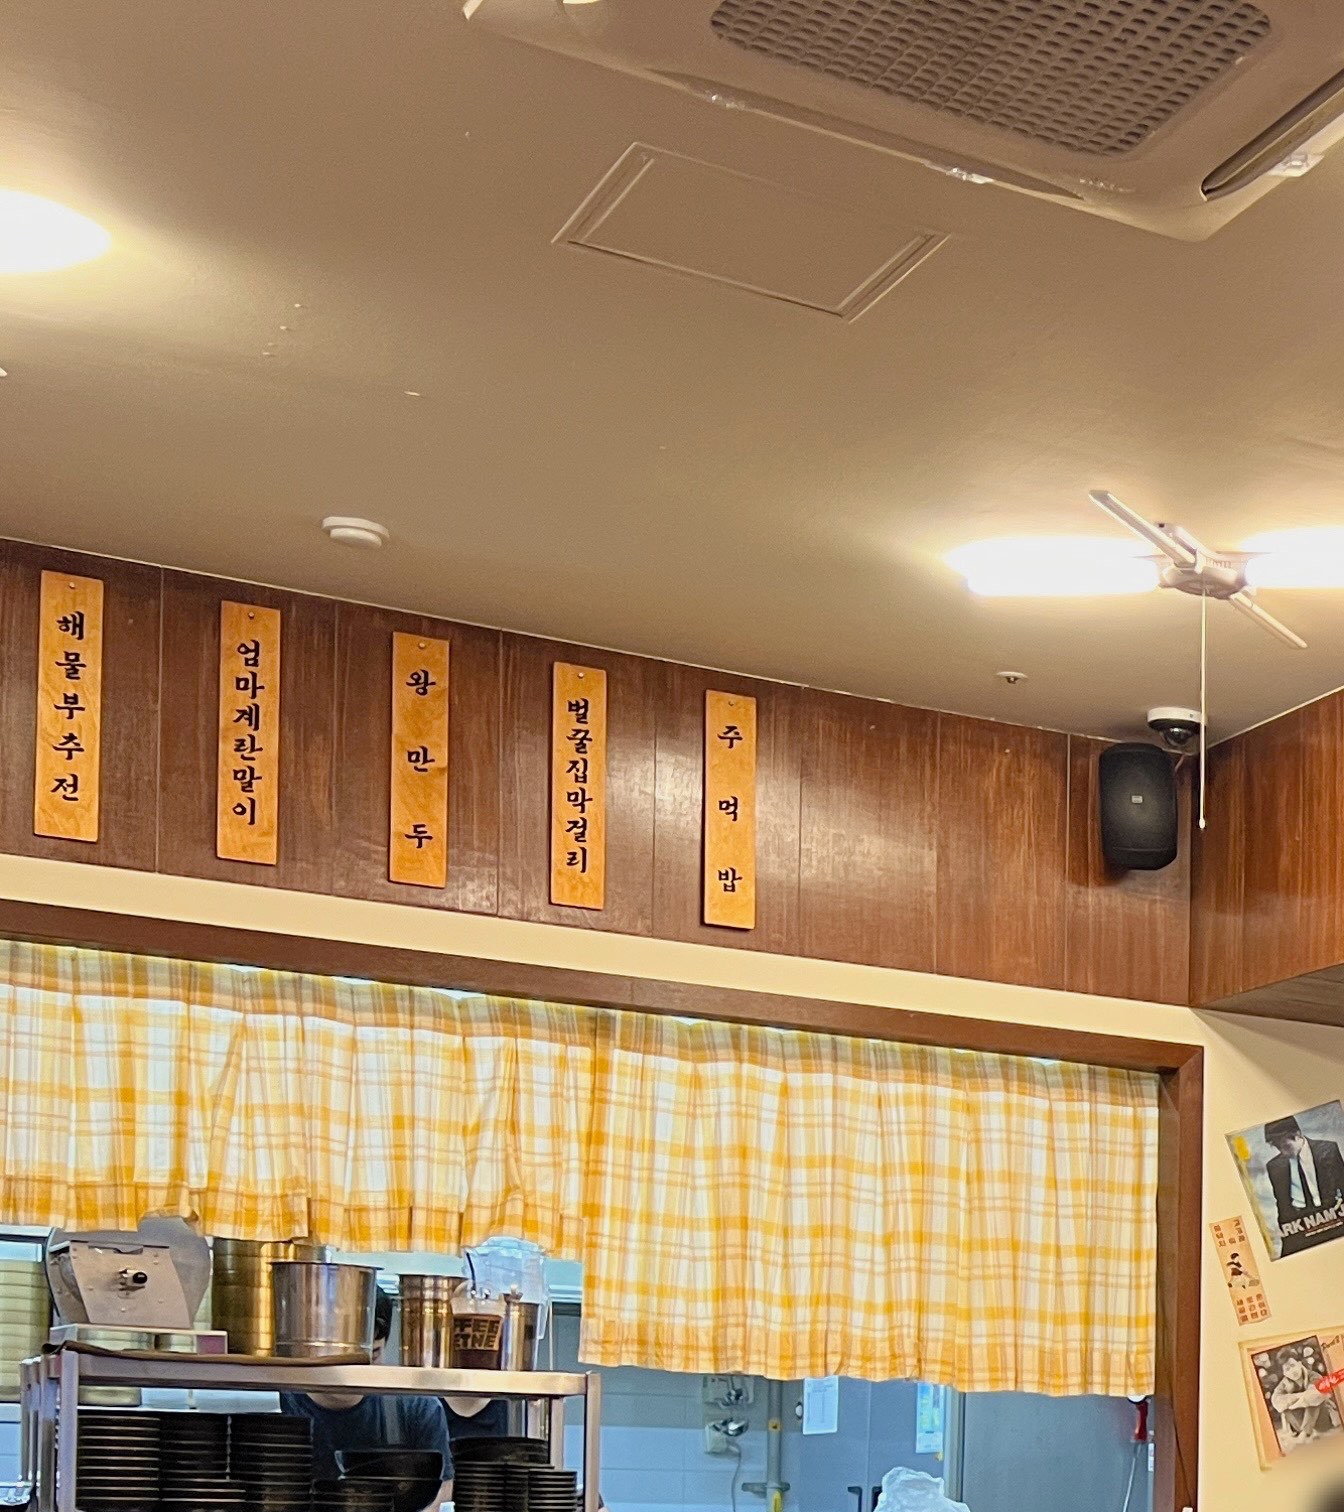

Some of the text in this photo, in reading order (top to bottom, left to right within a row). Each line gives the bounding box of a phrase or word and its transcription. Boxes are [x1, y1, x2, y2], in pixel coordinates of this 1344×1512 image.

[50, 609, 88, 803] 해물부추전
[231, 638, 266, 827] 엄마계란말이
[404, 668, 437, 850] 왕만두
[564, 696, 594, 875] 벌꿀집막걸리
[716, 724, 744, 894] 주먹밥
